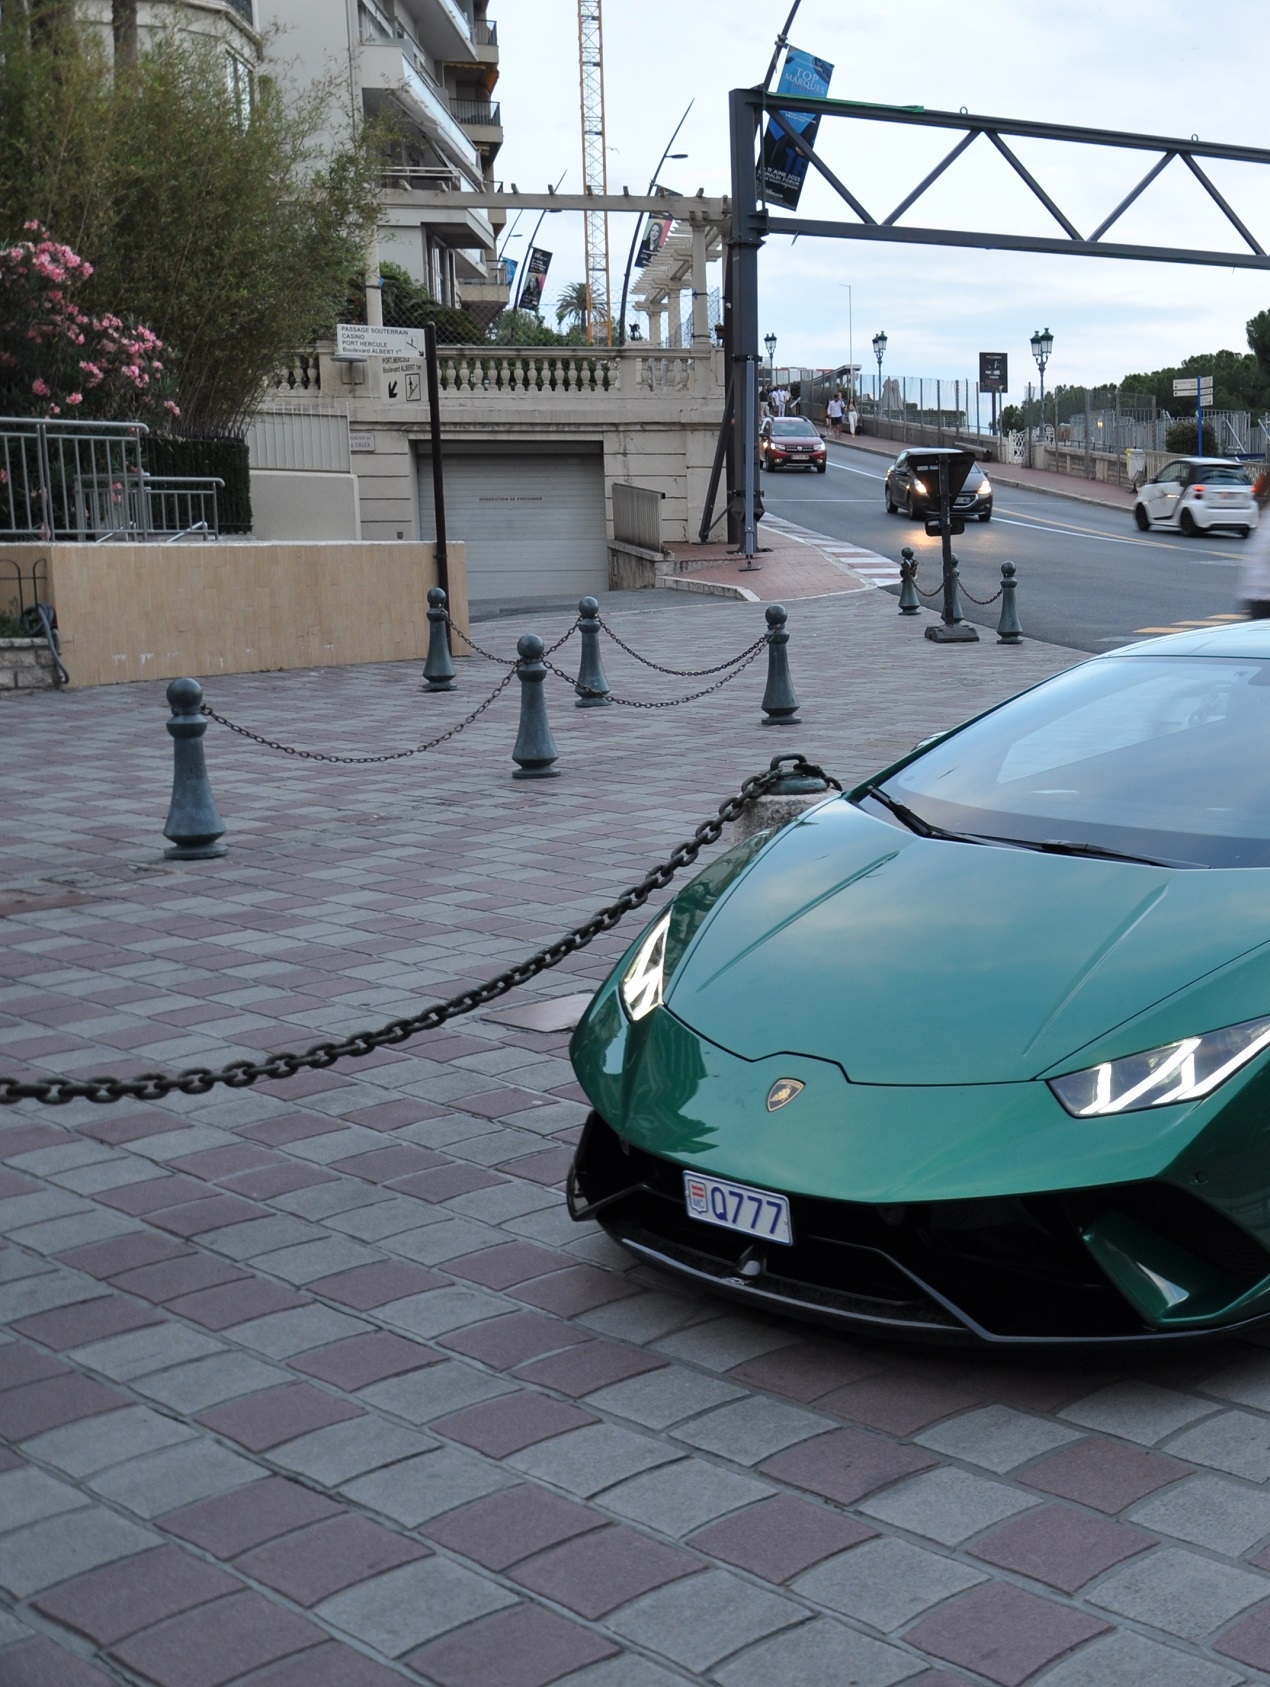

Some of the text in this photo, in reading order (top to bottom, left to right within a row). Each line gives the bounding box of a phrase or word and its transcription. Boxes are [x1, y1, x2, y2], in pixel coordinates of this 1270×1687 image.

[785, 73, 825, 94] MARQUES
[796, 66, 819, 83] TOP
[711, 1186, 783, 1235] Q777
